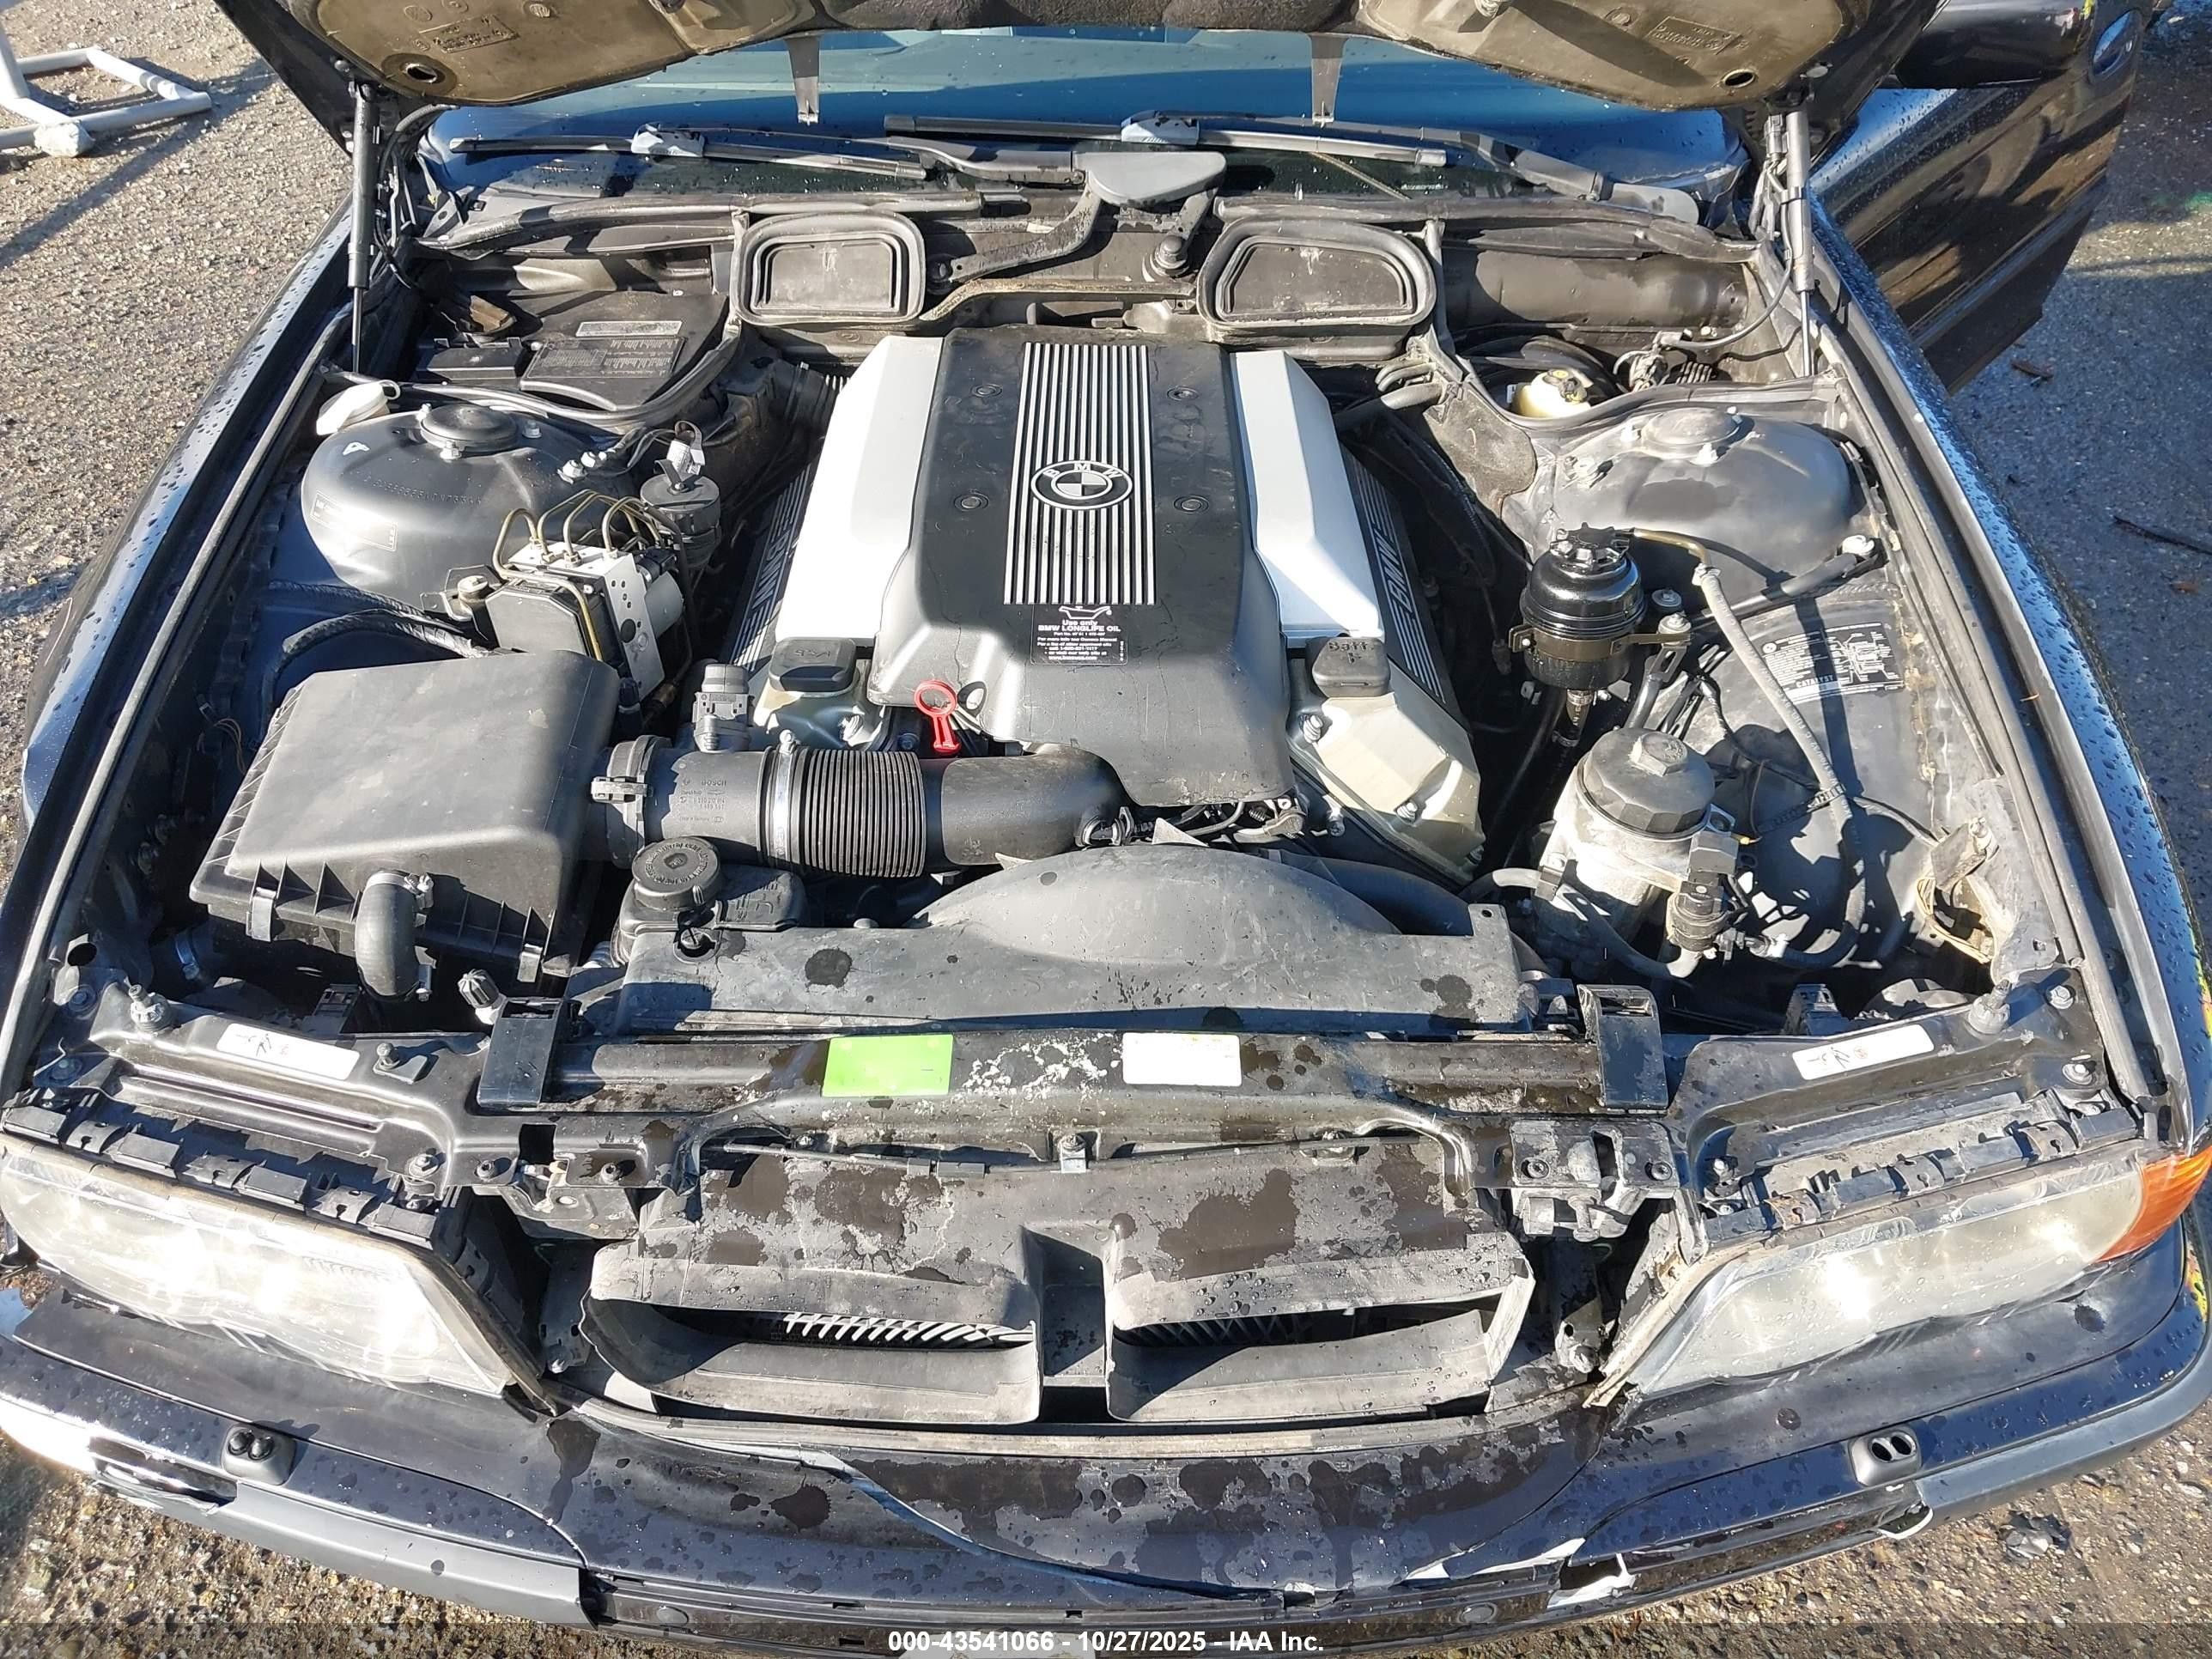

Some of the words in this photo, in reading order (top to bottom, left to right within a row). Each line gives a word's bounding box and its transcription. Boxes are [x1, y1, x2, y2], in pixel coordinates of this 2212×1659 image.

[1043, 463, 1123, 478] BMW
[751, 529, 790, 609] BMW
[1373, 528, 1413, 612] BMW
[1796, 674, 1834, 688] CATALYST
[701, 778, 727, 787] BOSCH
